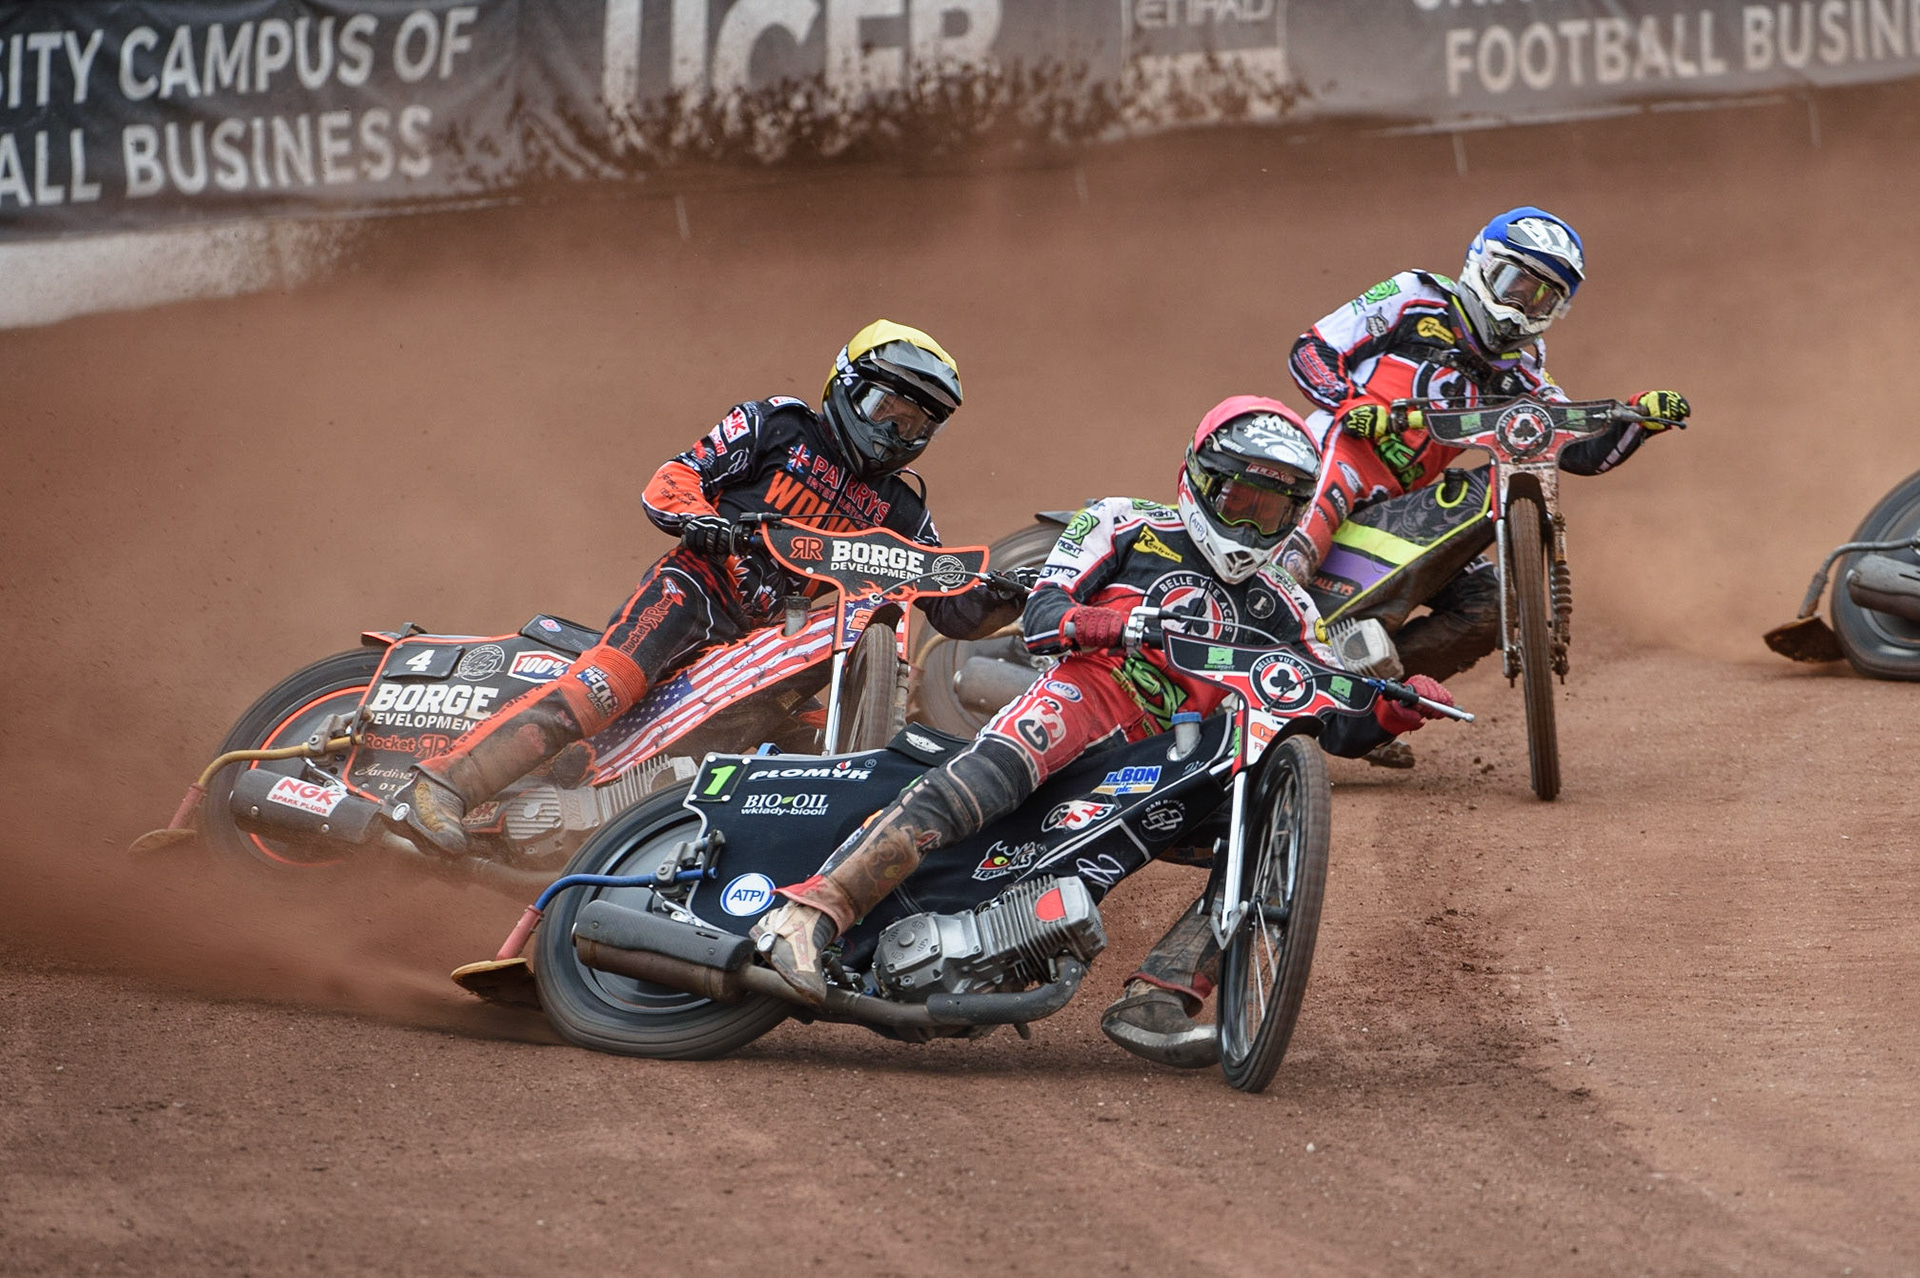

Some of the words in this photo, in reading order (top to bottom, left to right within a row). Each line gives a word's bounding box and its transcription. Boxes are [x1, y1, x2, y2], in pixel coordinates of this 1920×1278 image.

[0, 29, 104, 109] ITY
[118, 14, 379, 101] CAMPUS
[393, 7, 478, 82] OF
[1445, 12, 1727, 96] FOOTBALL
[121, 105, 434, 198] BUSINESS
[831, 540, 925, 575] BORGE
[830, 562, 921, 583] DEVELOPMENT
[1158, 576, 1194, 593] BELLE
[1219, 601, 1234, 633] ACES
[405, 649, 436, 672] 4
[515, 656, 568, 677] 100%
[1254, 655, 1277, 673] BELLE
[1278, 655, 1296, 667] VUE
[369, 683, 500, 720] BORGE
[371, 712, 476, 731] EVELOPMEN
[365, 732, 417, 753] Rocket
[354, 763, 413, 780] Jardine
[703, 765, 737, 796] 1
[271, 793, 298, 806] SPARK
[299, 802, 328, 814] PLUGS
[277, 779, 341, 806] NGK
[730, 889, 765, 903] ATPI
